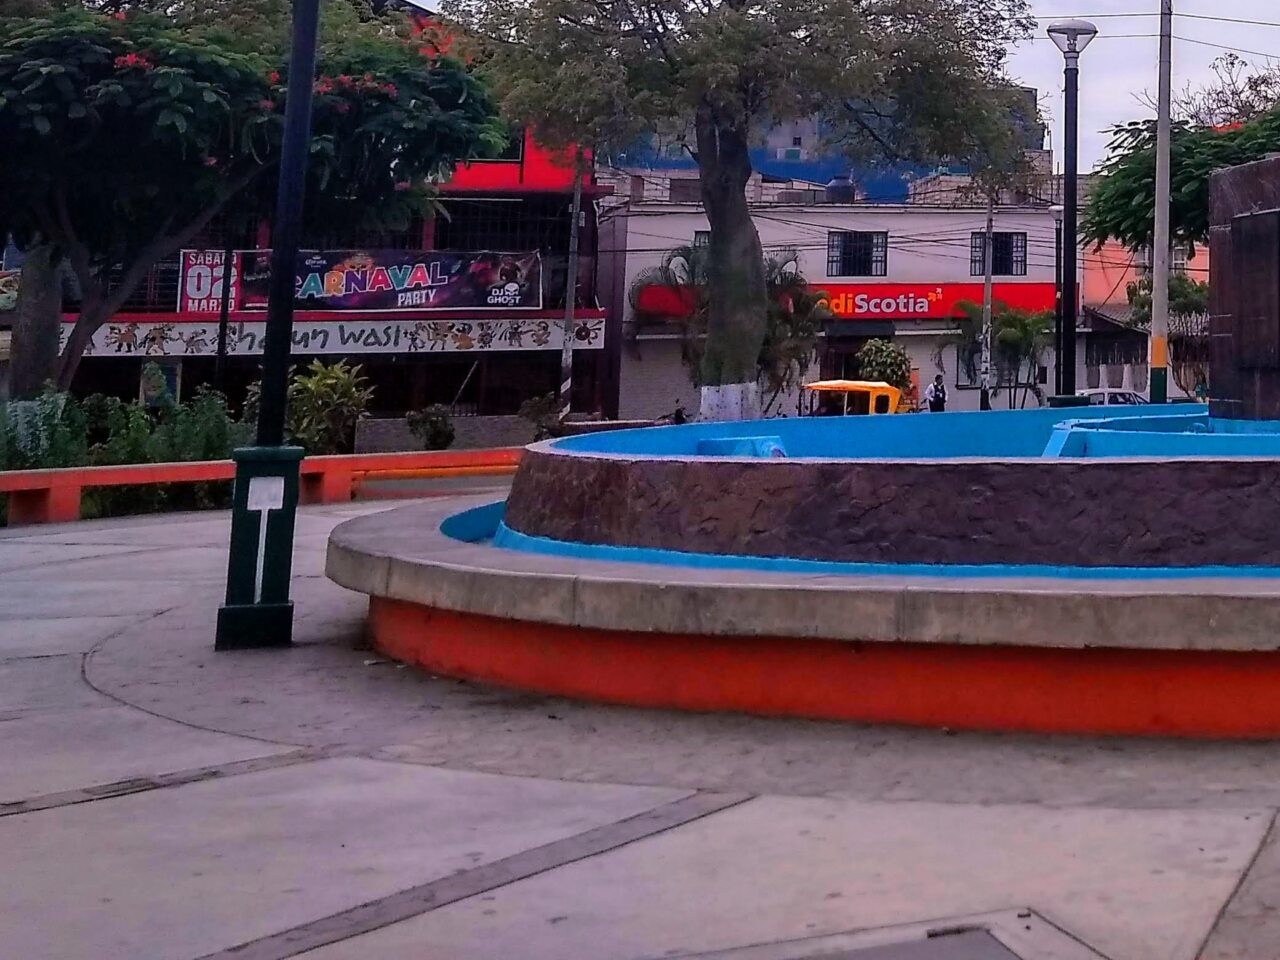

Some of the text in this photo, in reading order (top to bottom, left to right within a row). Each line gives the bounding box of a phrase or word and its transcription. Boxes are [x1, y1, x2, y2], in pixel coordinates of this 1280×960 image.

[186, 264, 238, 299] 02
[397, 289, 437, 306] PARTY
[491, 288, 504, 296] DJ
[487, 296, 521, 306] GHOST
